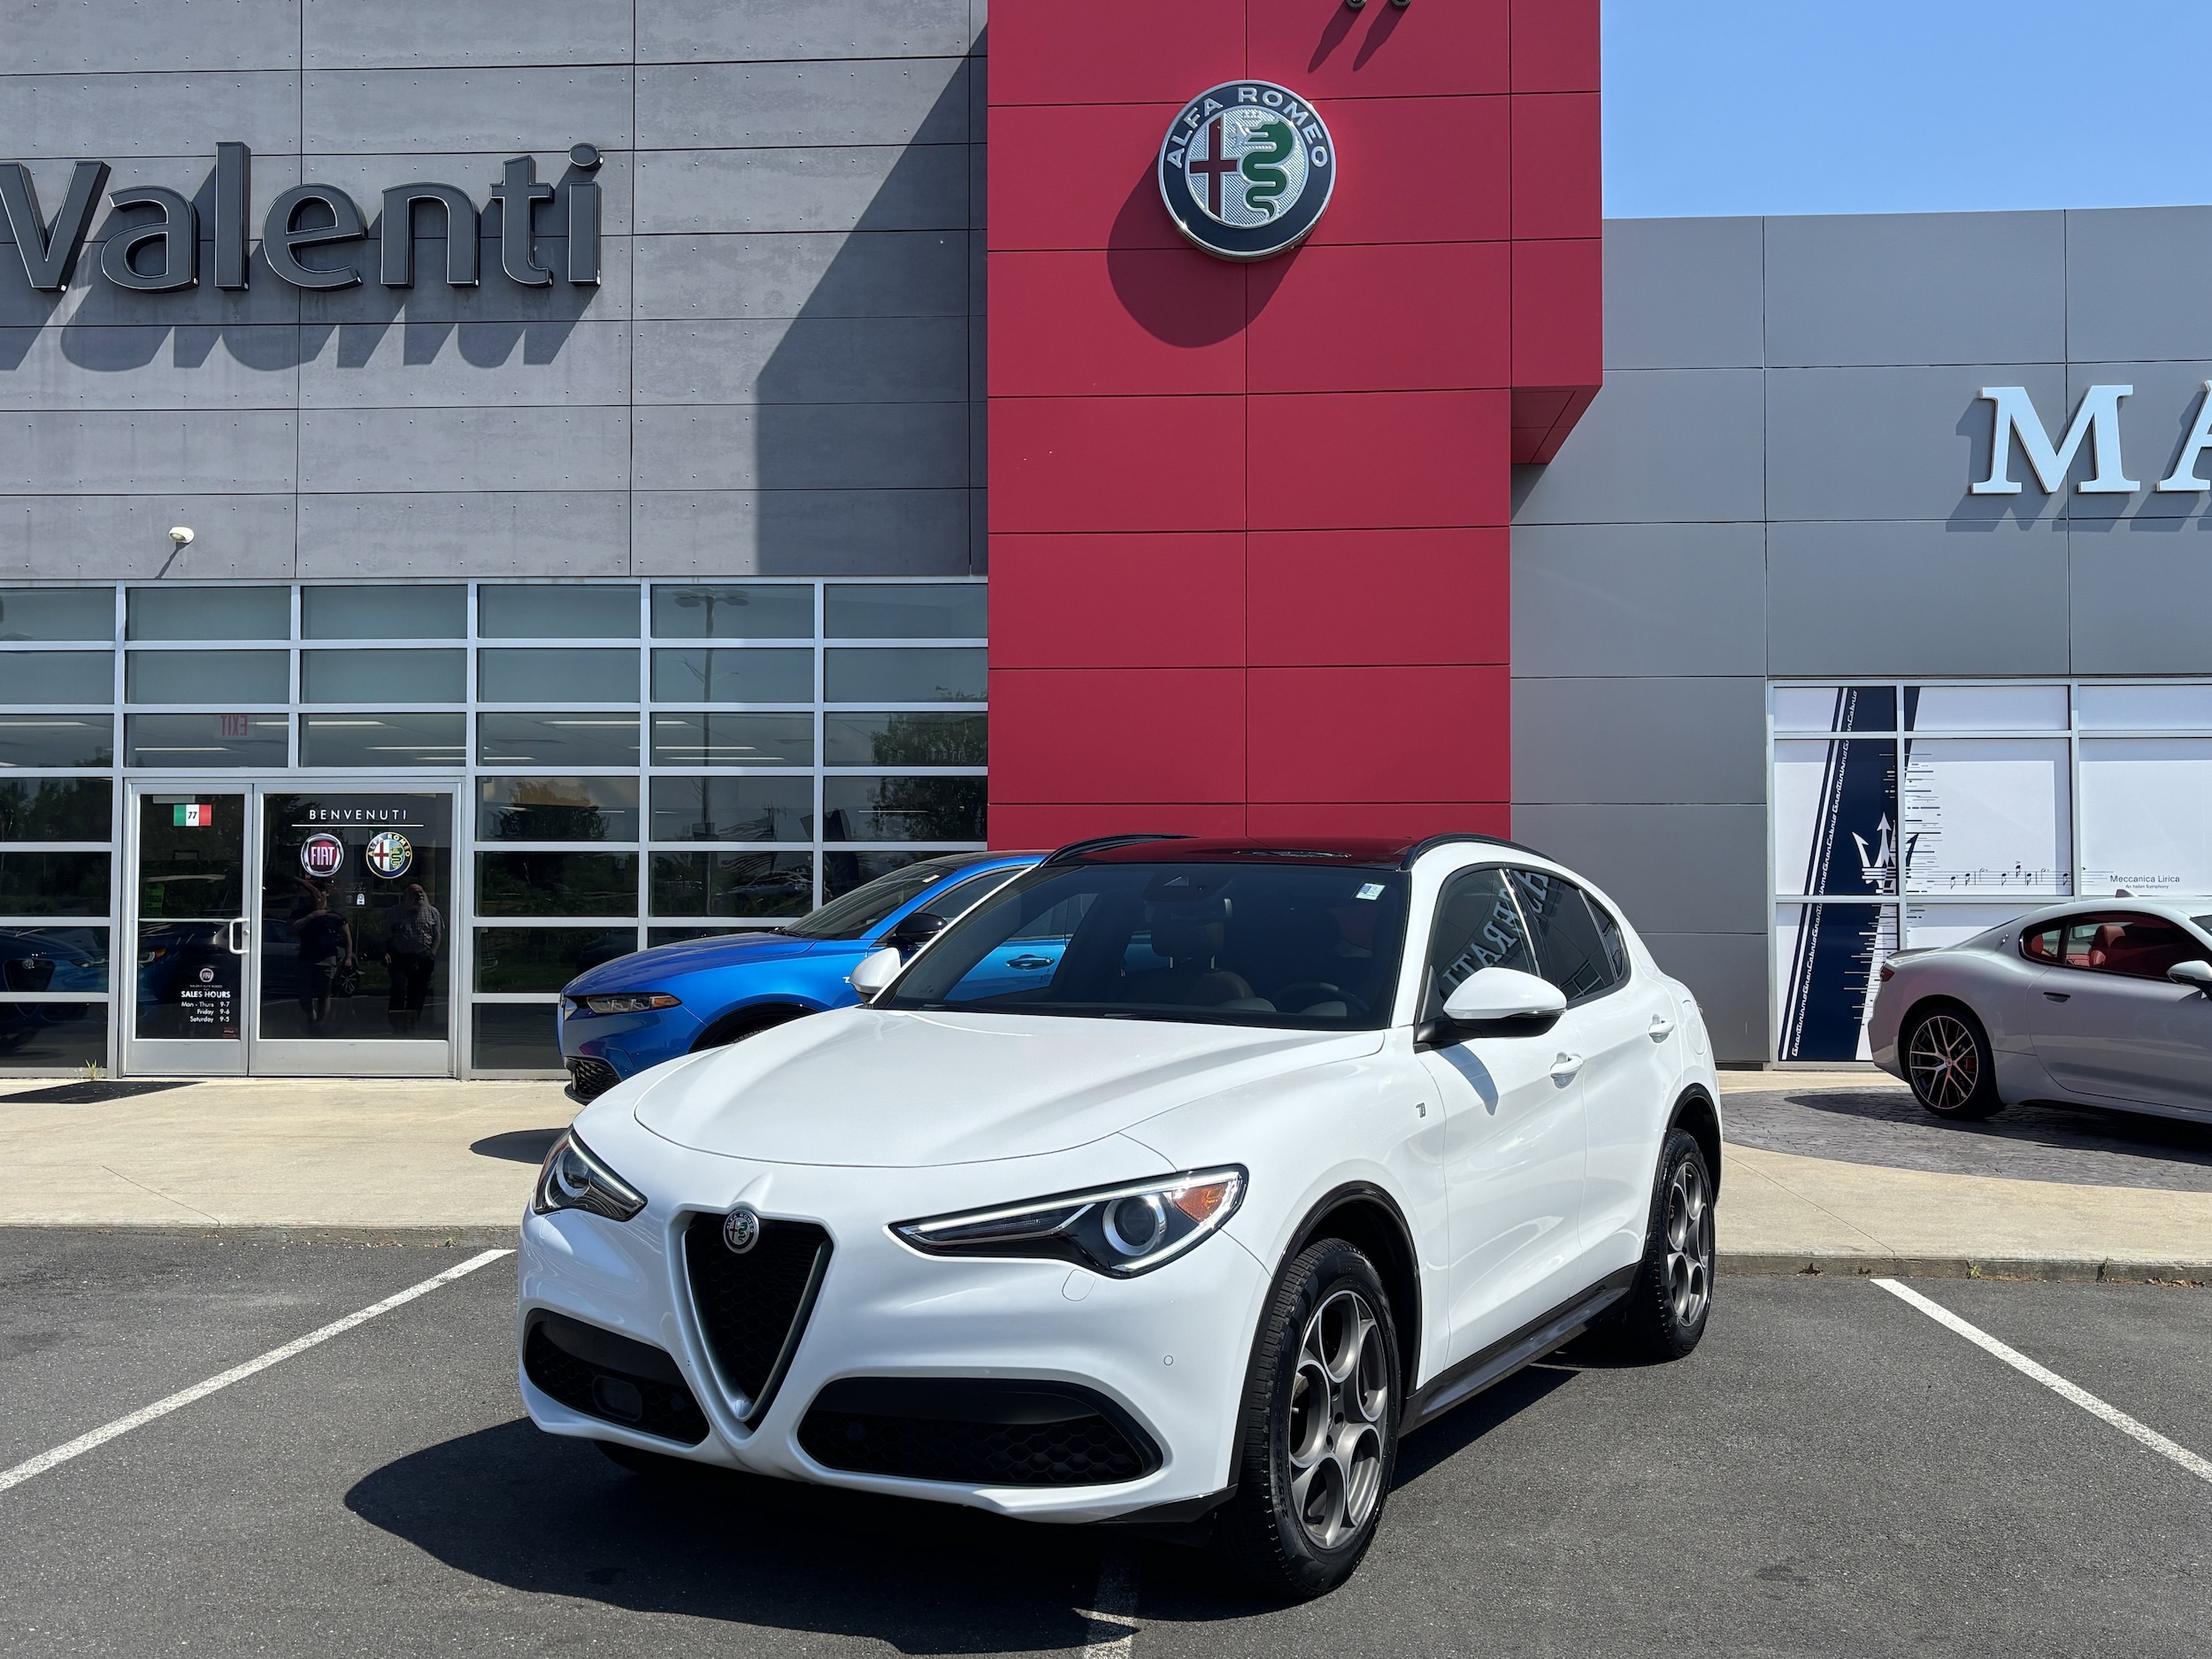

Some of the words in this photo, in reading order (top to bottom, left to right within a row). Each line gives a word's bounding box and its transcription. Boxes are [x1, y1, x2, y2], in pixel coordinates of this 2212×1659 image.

[1166, 97, 1224, 169] ALFA
[1238, 87, 1328, 168] ROMEO
[0, 142, 603, 292] Valenti
[309, 810, 407, 820] BENVENUTI
[311, 846, 335, 866] FIAT
[368, 836, 384, 857] ALFA
[388, 833, 411, 857] ROMEO
